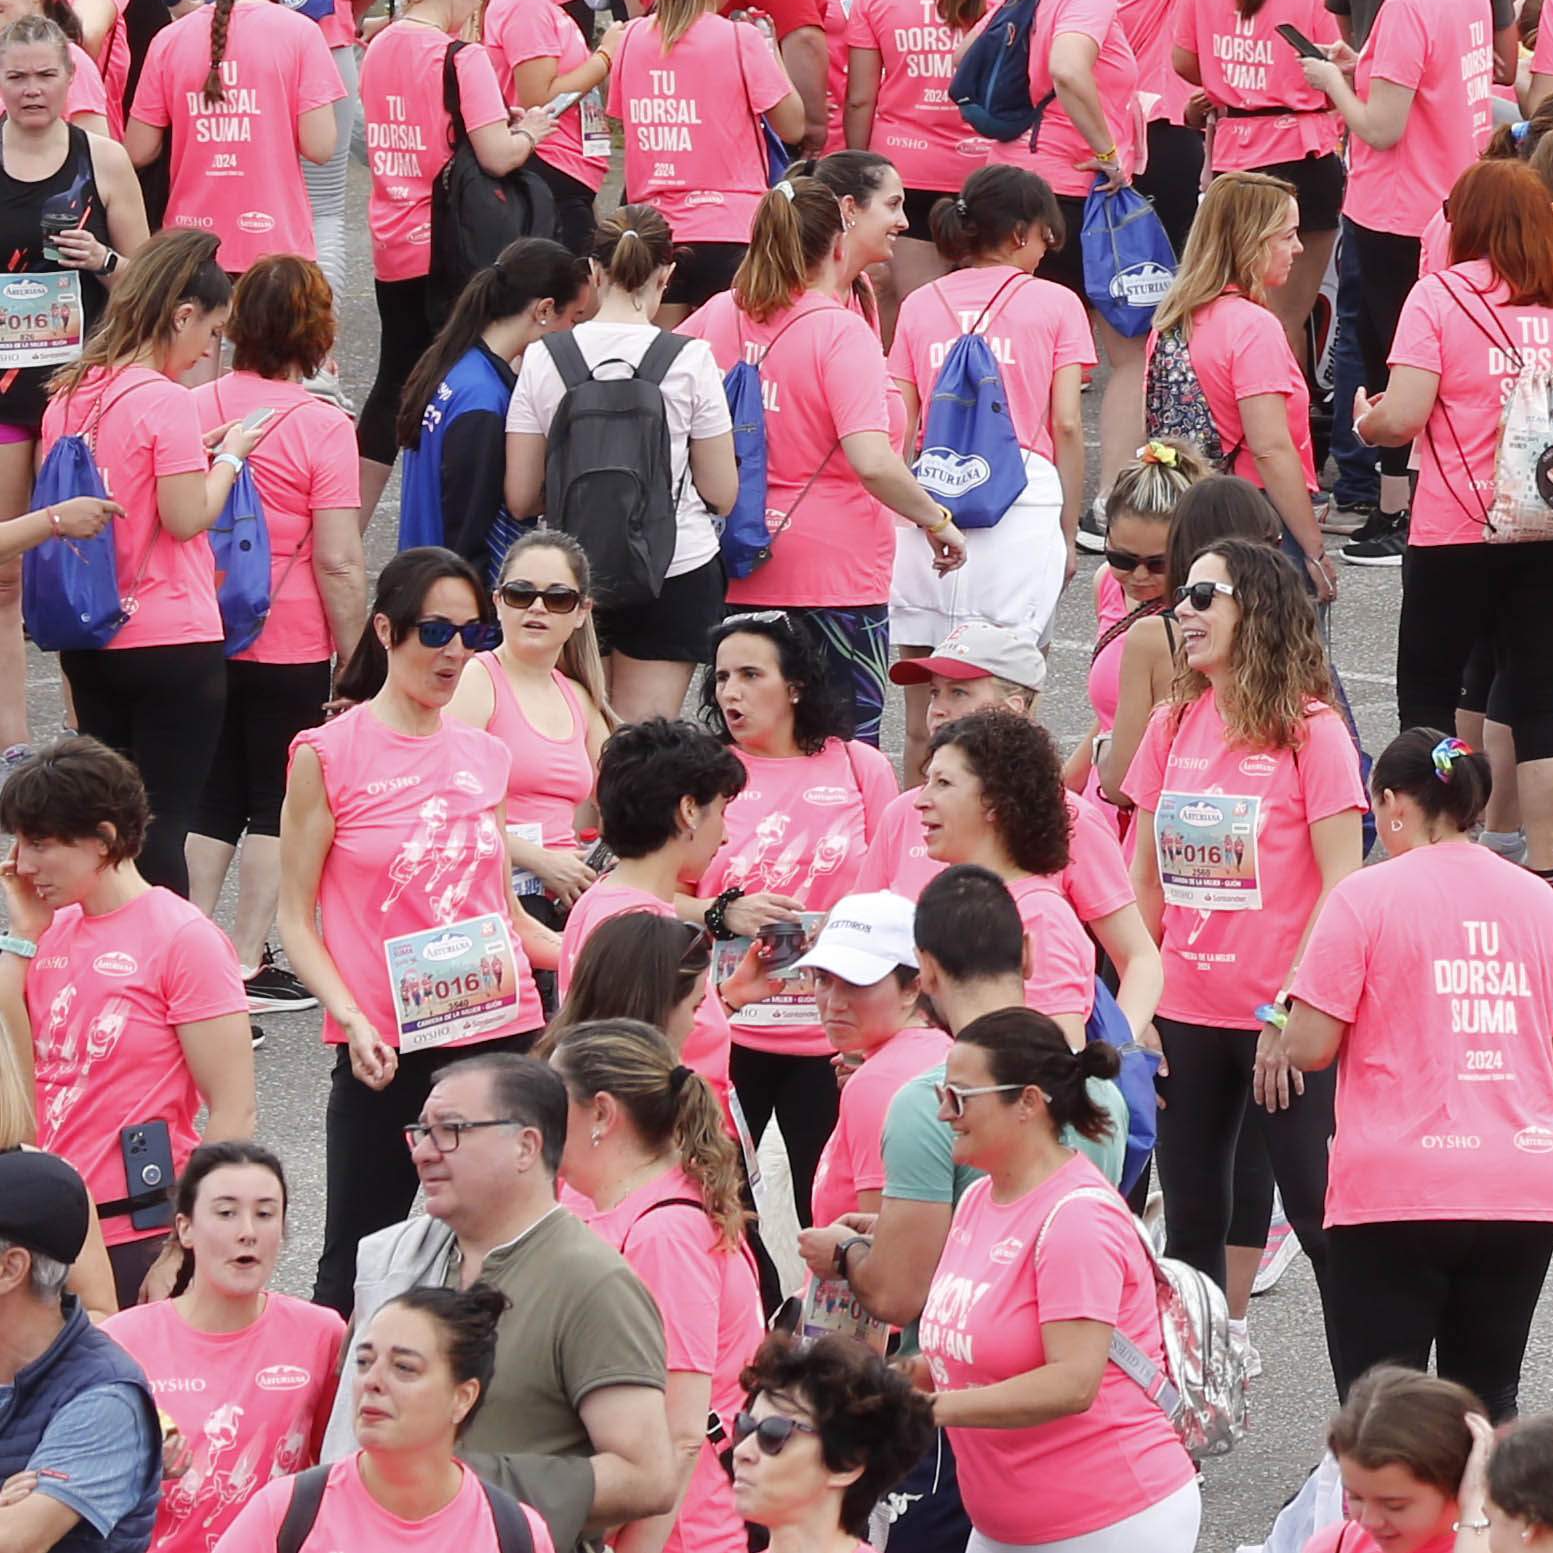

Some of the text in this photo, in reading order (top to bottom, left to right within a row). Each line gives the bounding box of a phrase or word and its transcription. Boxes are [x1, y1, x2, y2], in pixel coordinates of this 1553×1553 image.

[895, 28, 964, 52] DORSA
[1469, 22, 1484, 47] TU
[1213, 34, 1274, 65] DORSAL
[907, 55, 957, 78] SUM
[1462, 45, 1493, 80] DORSA
[649, 70, 675, 95] TU
[1467, 75, 1490, 106] SUM
[386, 96, 405, 121] TU
[924, 89, 948, 103] 2024
[630, 98, 702, 124] DORSAL
[197, 117, 251, 143] SUMA
[368, 123, 427, 150] DORSAL
[637, 126, 693, 151] SUMA
[887, 136, 928, 150] OYSHO
[374, 151, 422, 177] SUMA
[8, 314, 48, 330] 016
[1517, 316, 1549, 344] TU
[930, 336, 1016, 368] DAL
[1168, 754, 1209, 770] OYSHO
[367, 775, 421, 795] OYSHO
[1184, 845, 1222, 864] 016
[1463, 921, 1498, 956] TU
[435, 973, 480, 999] 016
[1434, 960, 1532, 997] DORSAL
[1451, 999, 1518, 1035] SUMA
[414, 1027, 450, 1044] OYSHO
[1466, 1050, 1504, 1070] 2024
[1422, 1136, 1480, 1149] OYSHO
